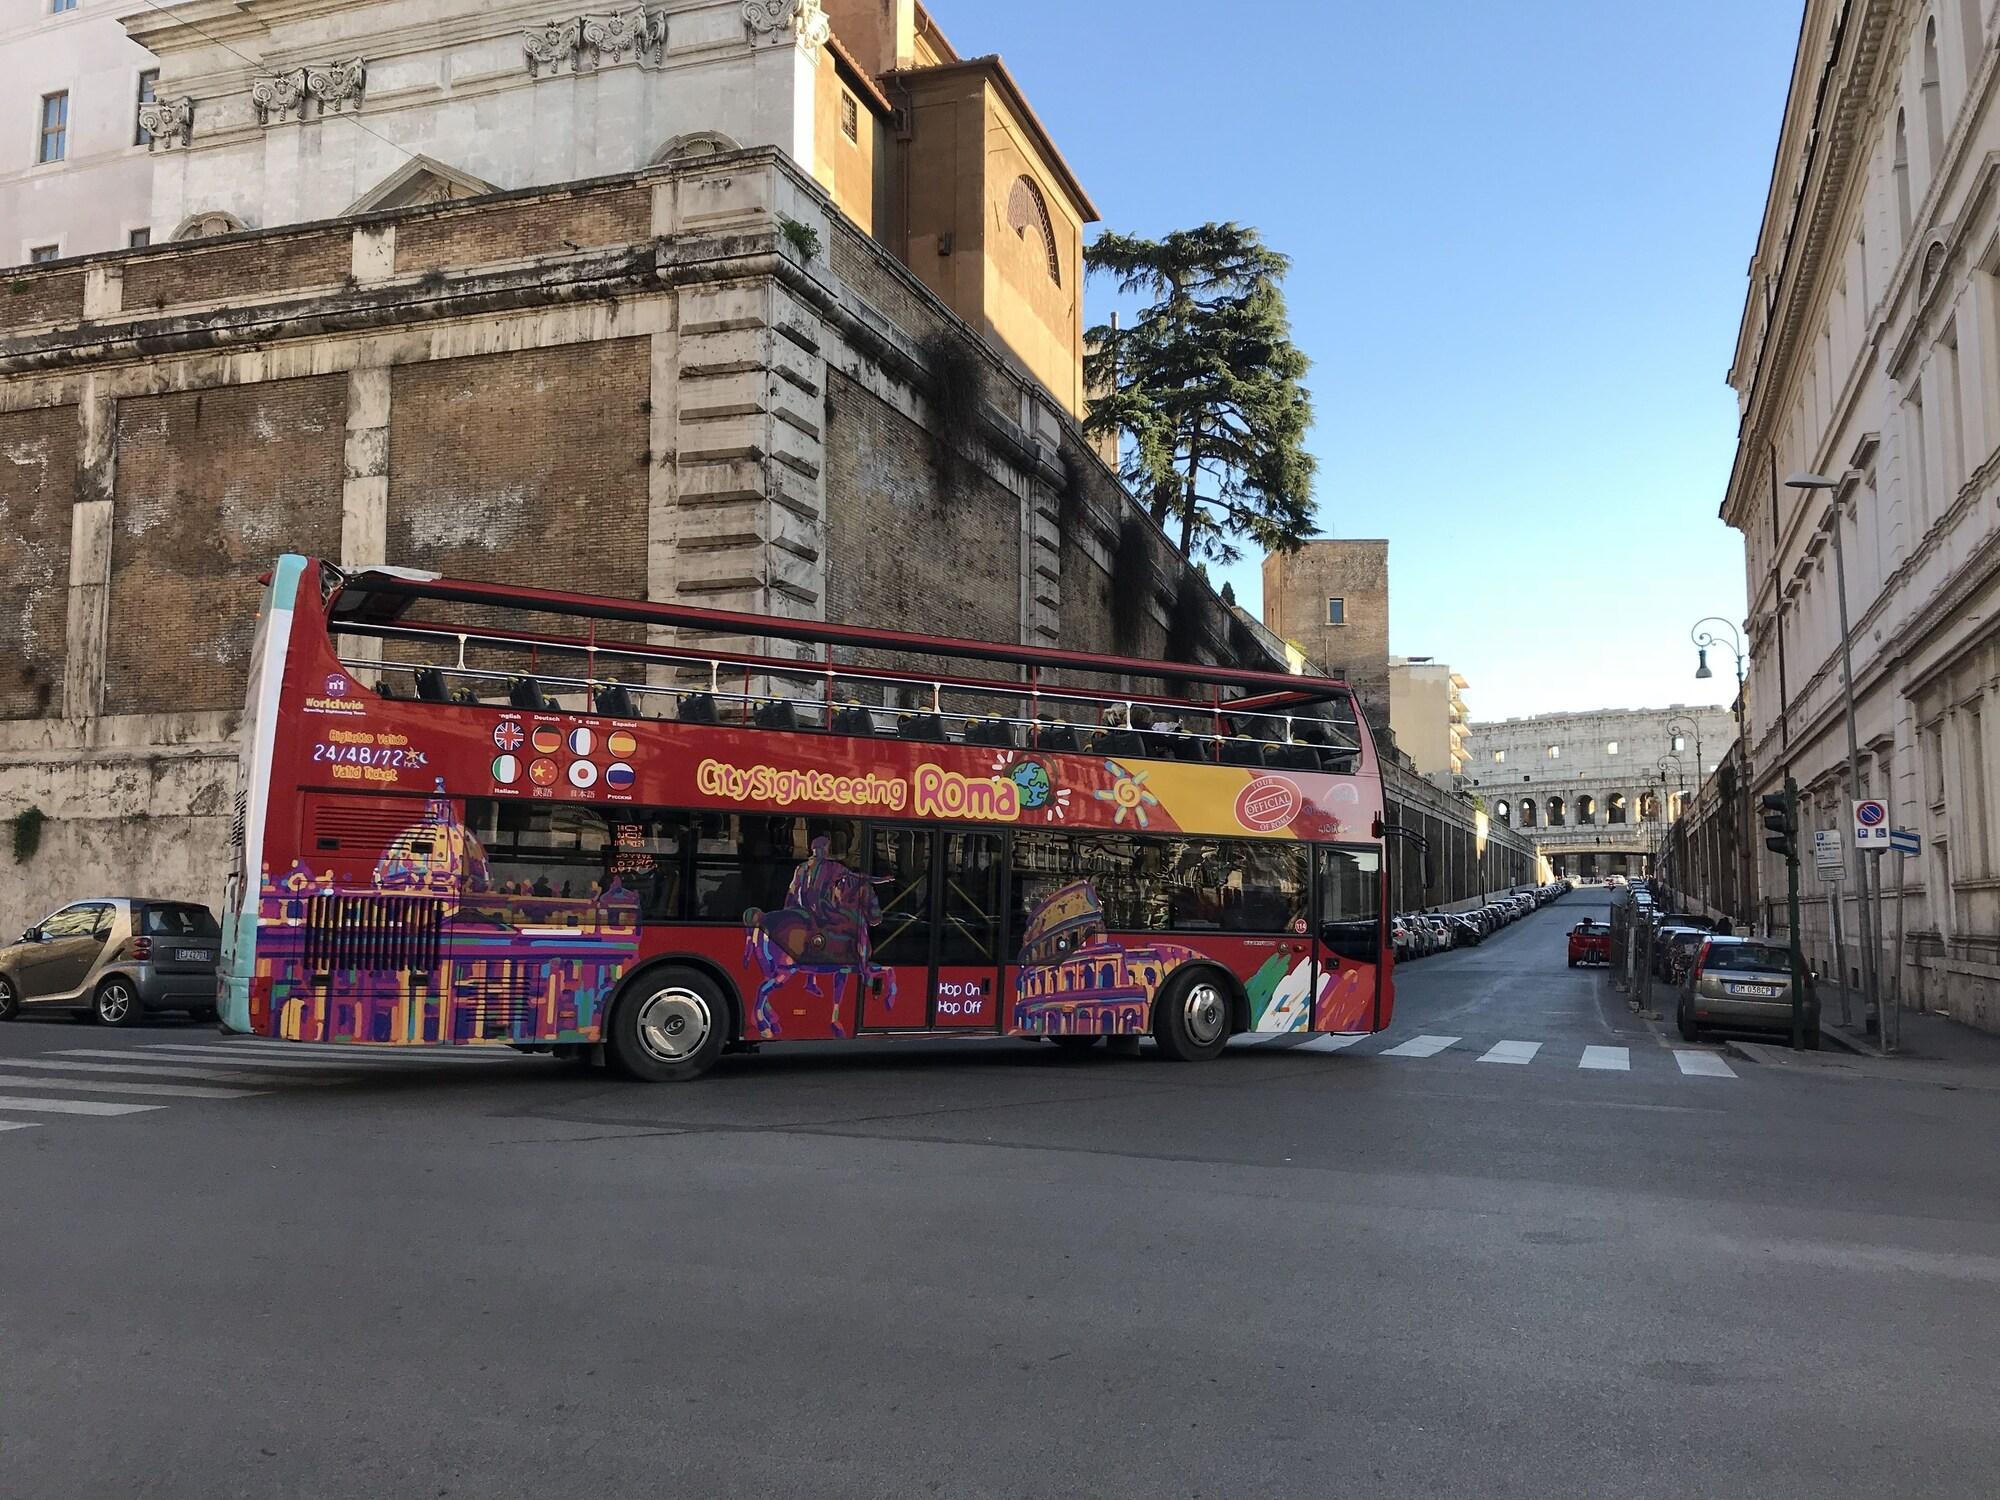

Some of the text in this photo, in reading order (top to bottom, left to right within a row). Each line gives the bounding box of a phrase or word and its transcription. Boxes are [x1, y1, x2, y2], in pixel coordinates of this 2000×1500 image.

[534, 714, 560, 722] Deutsch
[612, 720, 637, 728] Español
[329, 728, 408, 746] Biglietto Valido
[313, 744, 403, 766] 24/48/72
[332, 764, 398, 781] Valid Ticket
[494, 787, 519, 795] Italiano
[570, 789, 596, 799] 日本語
[607, 793, 632, 801] Русский
[697, 758, 1020, 822] CitySightseeing Roma
[1246, 792, 1289, 815] OFFICIAL
[1270, 814, 1292, 830] ROMA
[939, 982, 980, 997] Hop On
[937, 1000, 982, 1015] Hop Off
